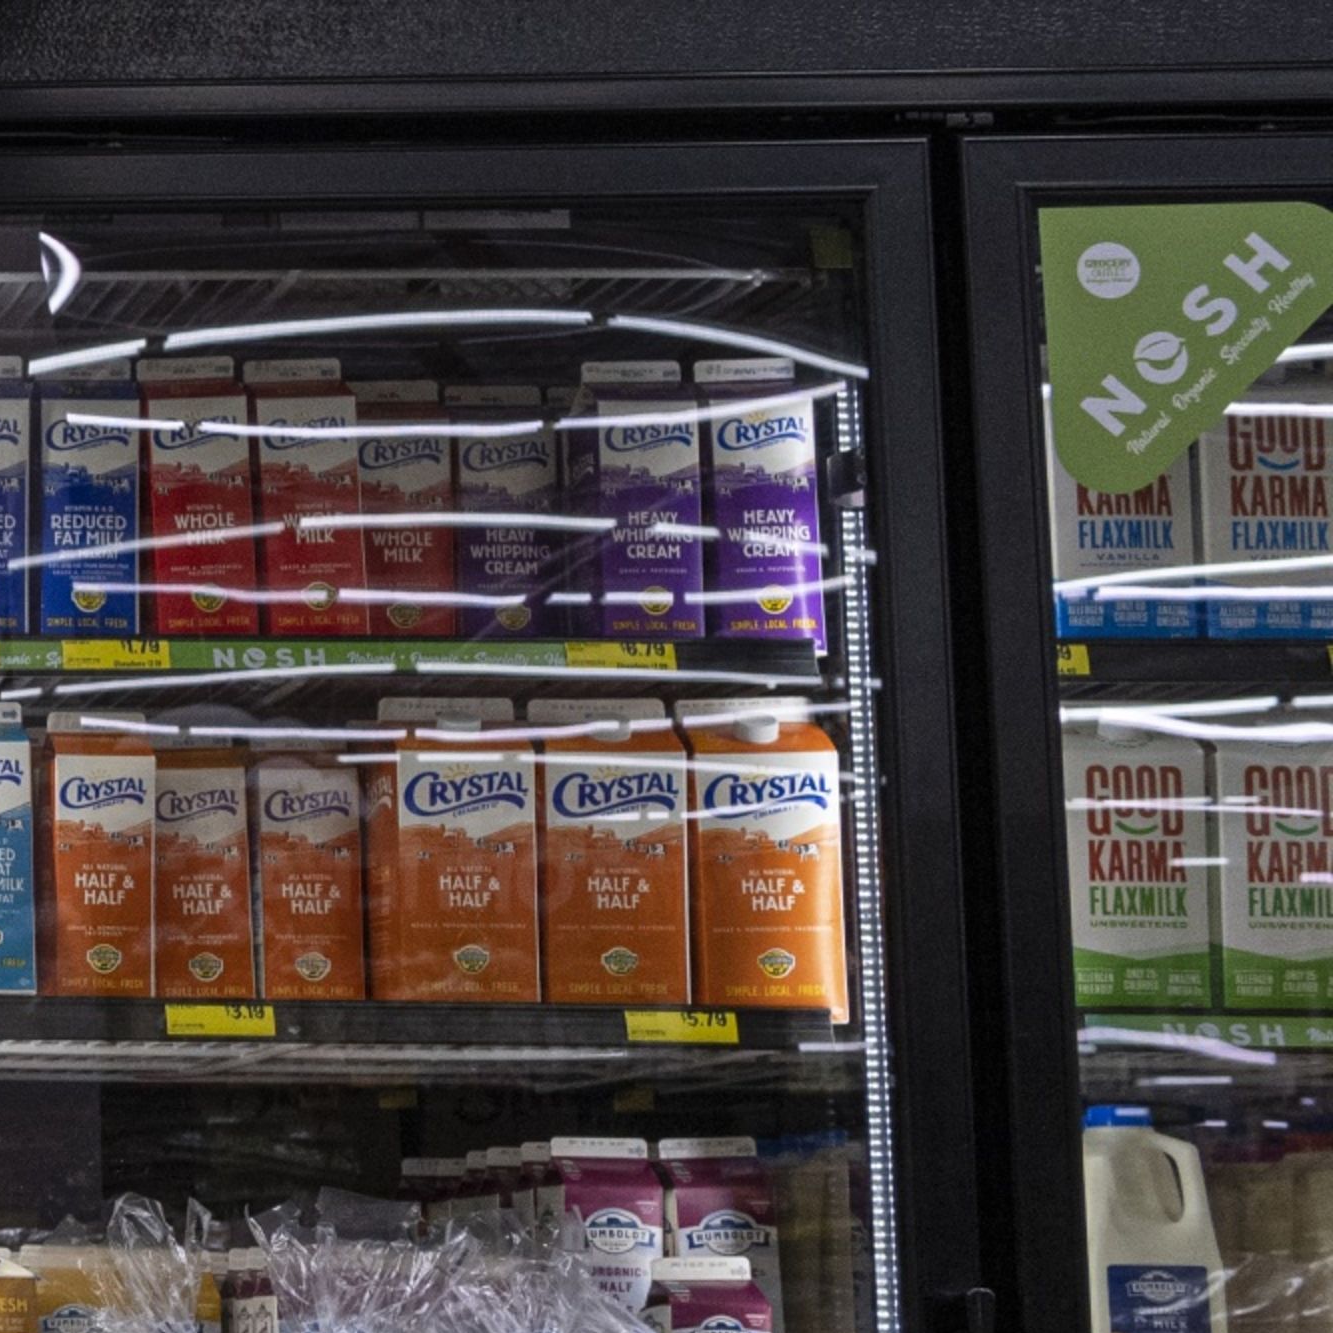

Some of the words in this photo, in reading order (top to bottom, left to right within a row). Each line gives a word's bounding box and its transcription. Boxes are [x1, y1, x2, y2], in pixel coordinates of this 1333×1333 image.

[1080, 232, 1291, 438] NOSH
[1127, 411, 1172, 455] Natural
[1173, 368, 1218, 410] Organic
[1220, 316, 1272, 365] Specialty
[1268, 273, 1316, 314] Healthy
[717, 416, 807, 451] CRYSTAL
[1229, 416, 1326, 471] GOOD
[1231, 476, 1329, 517] KARMA
[51, 513, 127, 530] REDUCED
[174, 513, 234, 528] WHOLE
[628, 512, 679, 524] HEAVY
[744, 509, 795, 524] HEAVY
[54, 531, 81, 546] FAT
[373, 532, 432, 546] WHOLE
[485, 529, 536, 542] HEAVY
[727, 527, 810, 541] WHIPPING
[1079, 520, 1173, 549] FLAXMILK
[1233, 521, 1329, 550] FLAXMILK
[384, 548, 422, 563] MILK
[470, 546, 551, 559] WHIPPING
[627, 545, 681, 560] CREAM
[213, 648, 326, 668] NOSH
[60, 777, 147, 809] CRYSTAL
[403, 771, 528, 817] CRYSTAL
[552, 772, 679, 819] CRYSTAL
[704, 773, 832, 819] CRYSTAL
[1087, 765, 1183, 836] GOOD
[1089, 840, 1187, 883] KARMA
[75, 874, 116, 889] HALF
[439, 875, 481, 891] HALF
[587, 878, 630, 893] HALF
[742, 880, 785, 894] HALF
[84, 890, 126, 905] HALF
[448, 892, 490, 907] HALF
[597, 895, 640, 910] HALF
[752, 896, 797, 911] HALF
[1089, 887, 1188, 917] FLAXMILK
[1090, 920, 1188, 929] UNSWEETENED
[695, 1231, 762, 1244] HUMBOLDT
